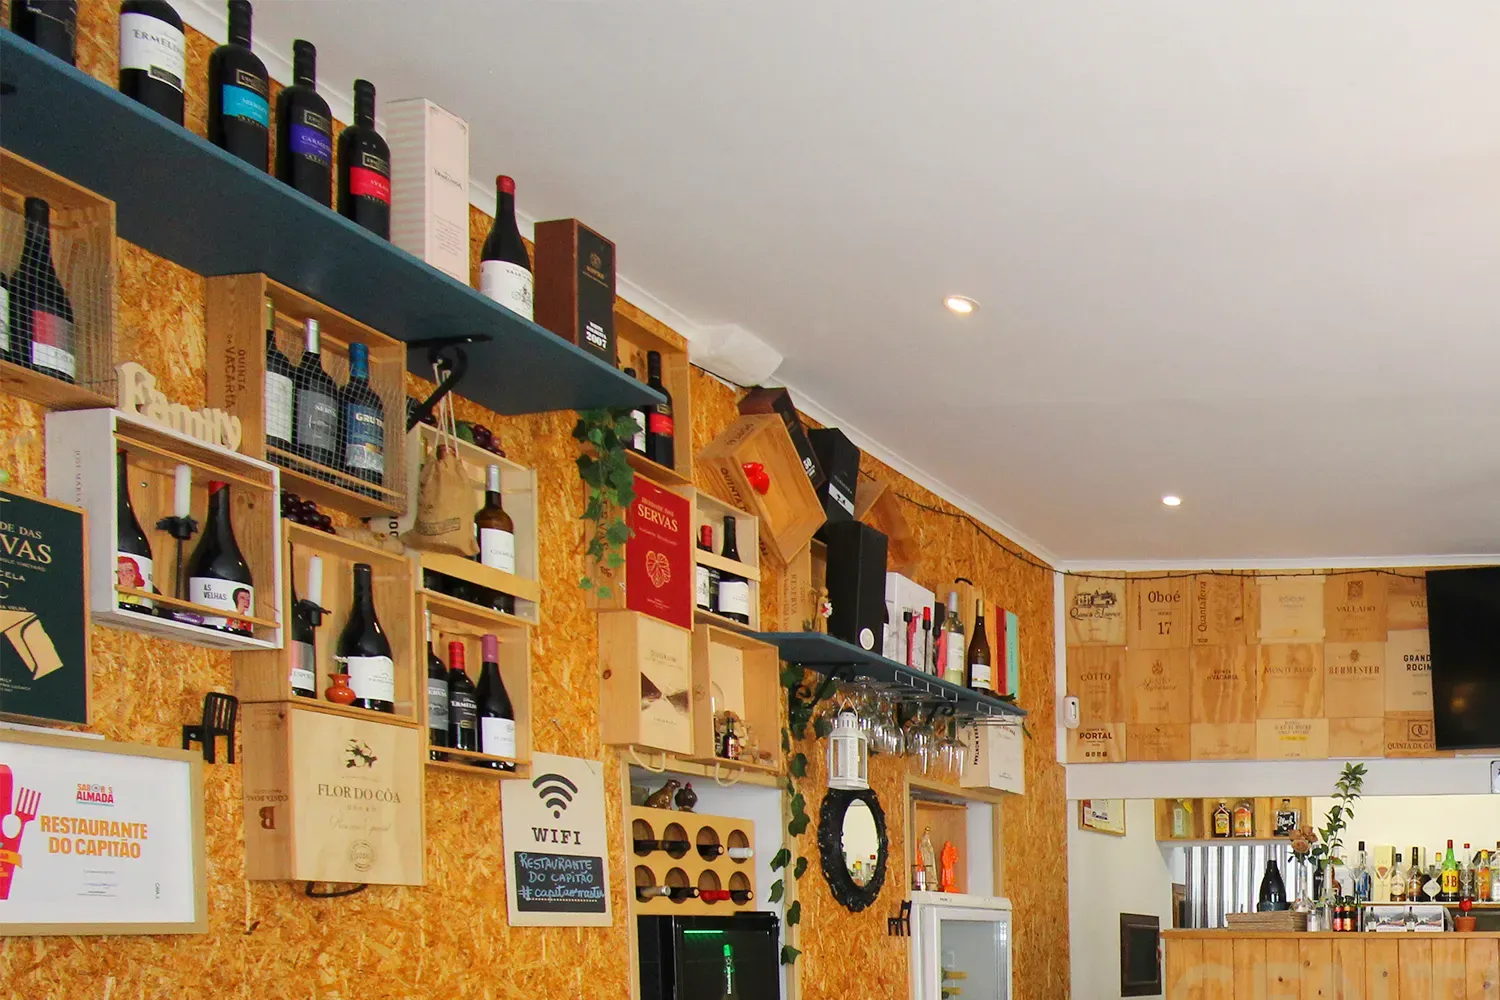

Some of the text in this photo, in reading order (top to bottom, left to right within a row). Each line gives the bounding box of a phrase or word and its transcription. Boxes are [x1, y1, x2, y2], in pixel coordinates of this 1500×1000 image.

[586, 331, 607, 349] 2007
[224, 346, 236, 409] VACARIA
[237, 349, 246, 391] QUINTA
[114, 361, 242, 452] Family
[638, 503, 679, 533] SERVAS
[19, 526, 43, 540] DAS
[203, 591, 228, 601] VELHAS
[1336, 605, 1376, 613] VALLADO
[1158, 621, 1172, 635] 17
[1329, 666, 1380, 675] BURMESTER
[1079, 732, 1112, 740] PORTAL
[1387, 742, 1412, 750] QUINTA
[76, 791, 114, 804] ALMADA
[318, 783, 352, 799] FLOR
[354, 786, 373, 800] DO
[259, 806, 276, 830] B
[40, 815, 148, 840] RESTAURANTE
[531, 827, 581, 845] WIFI
[48, 836, 141, 859] DO CAPITÃO
[519, 853, 593, 871] RESTAURANTE
[528, 871, 546, 883] DO
